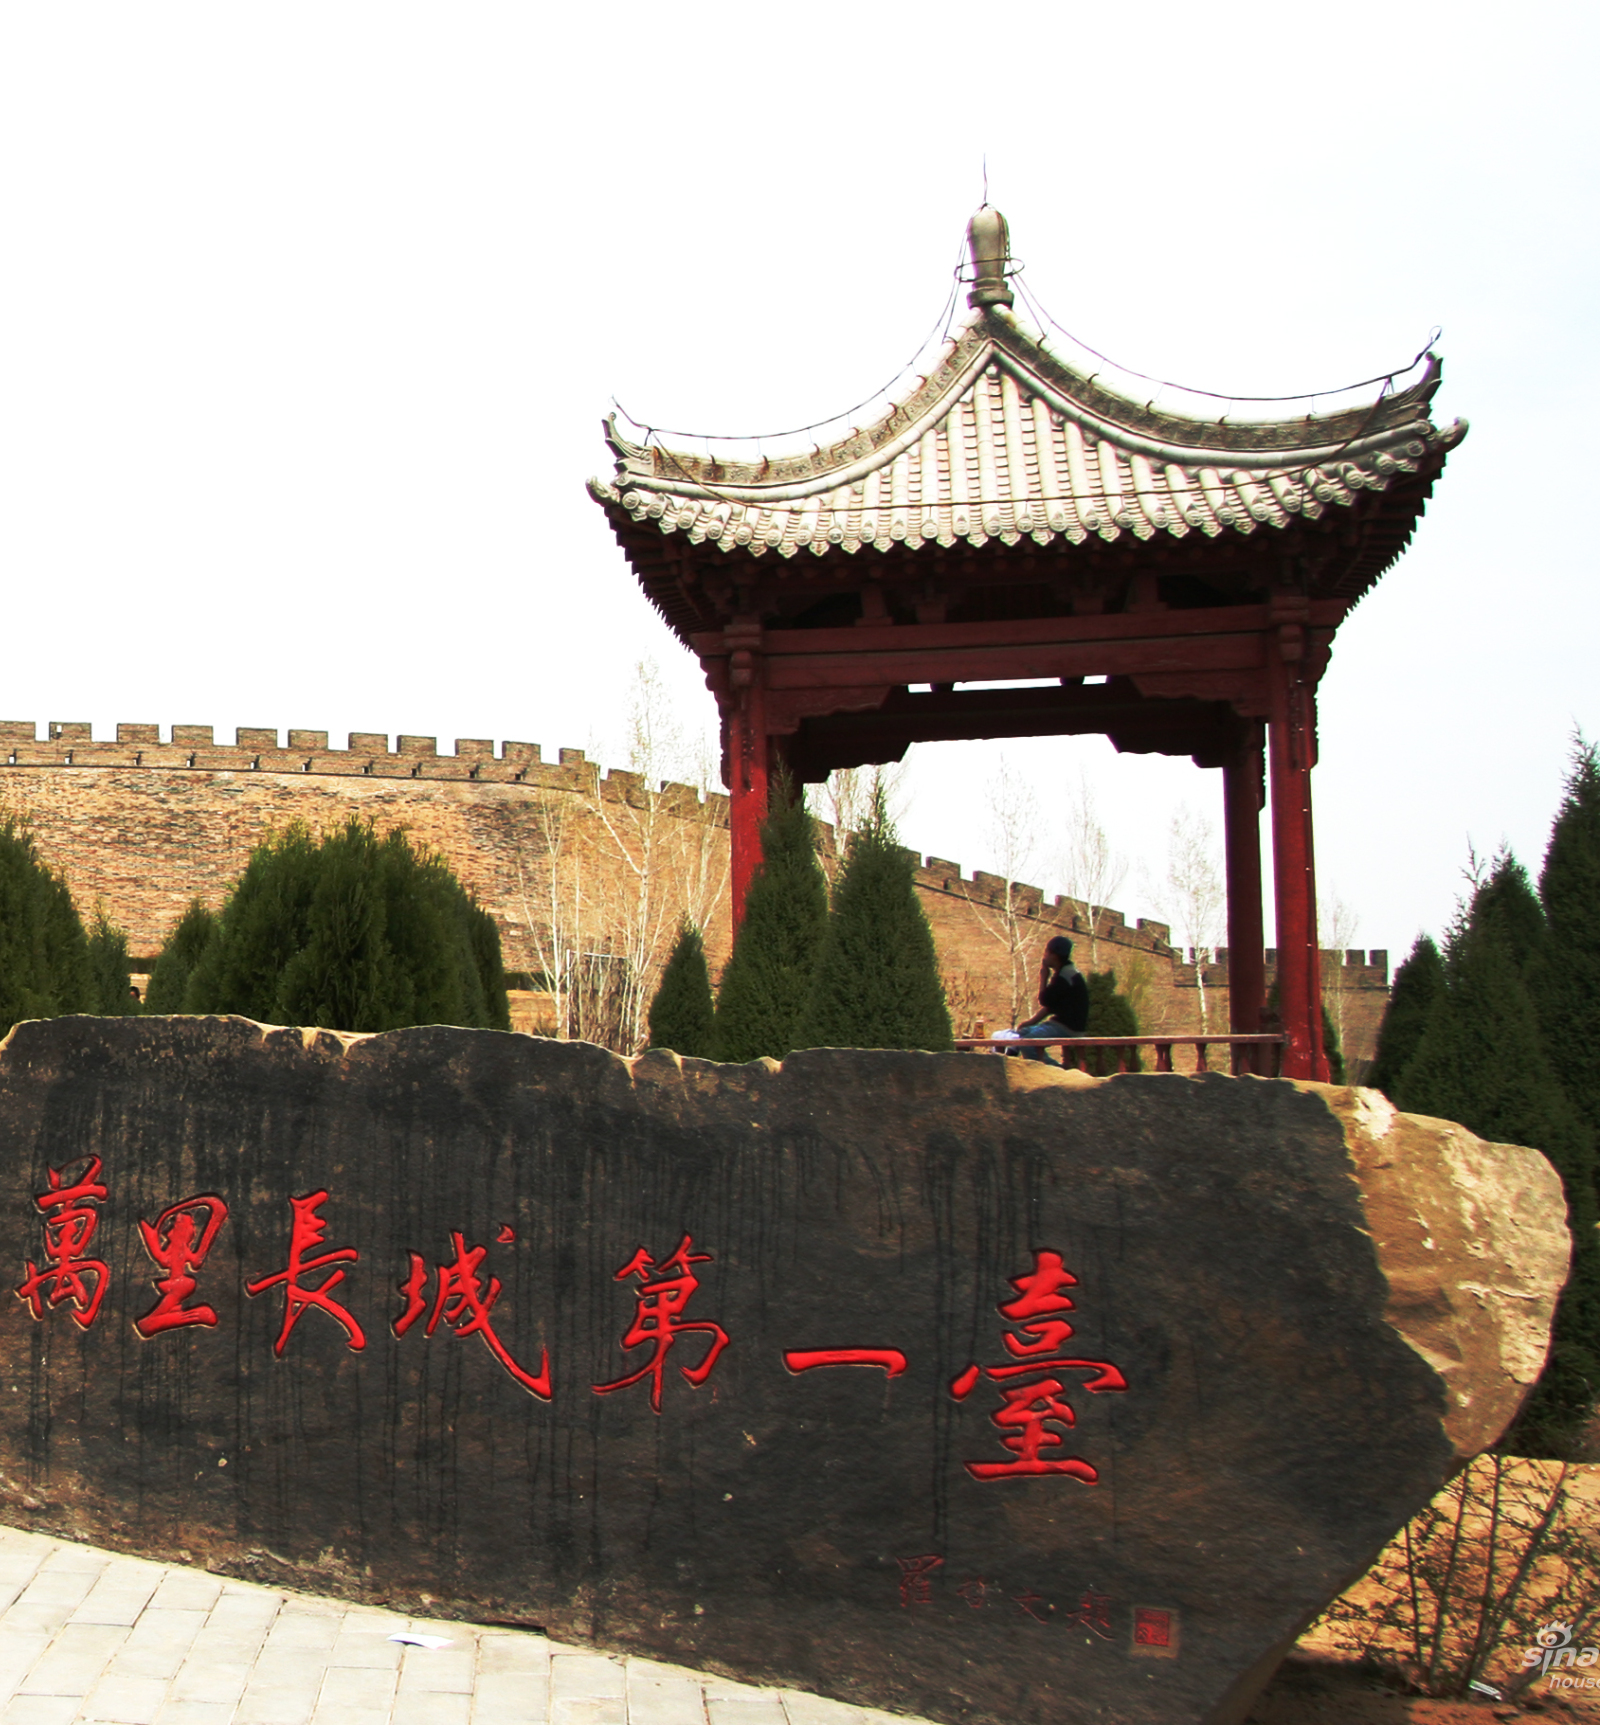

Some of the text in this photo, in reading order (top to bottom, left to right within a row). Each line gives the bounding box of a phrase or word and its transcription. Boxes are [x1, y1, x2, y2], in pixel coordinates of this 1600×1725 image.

[15, 1154, 1128, 1483] 萬里長城第一臺
